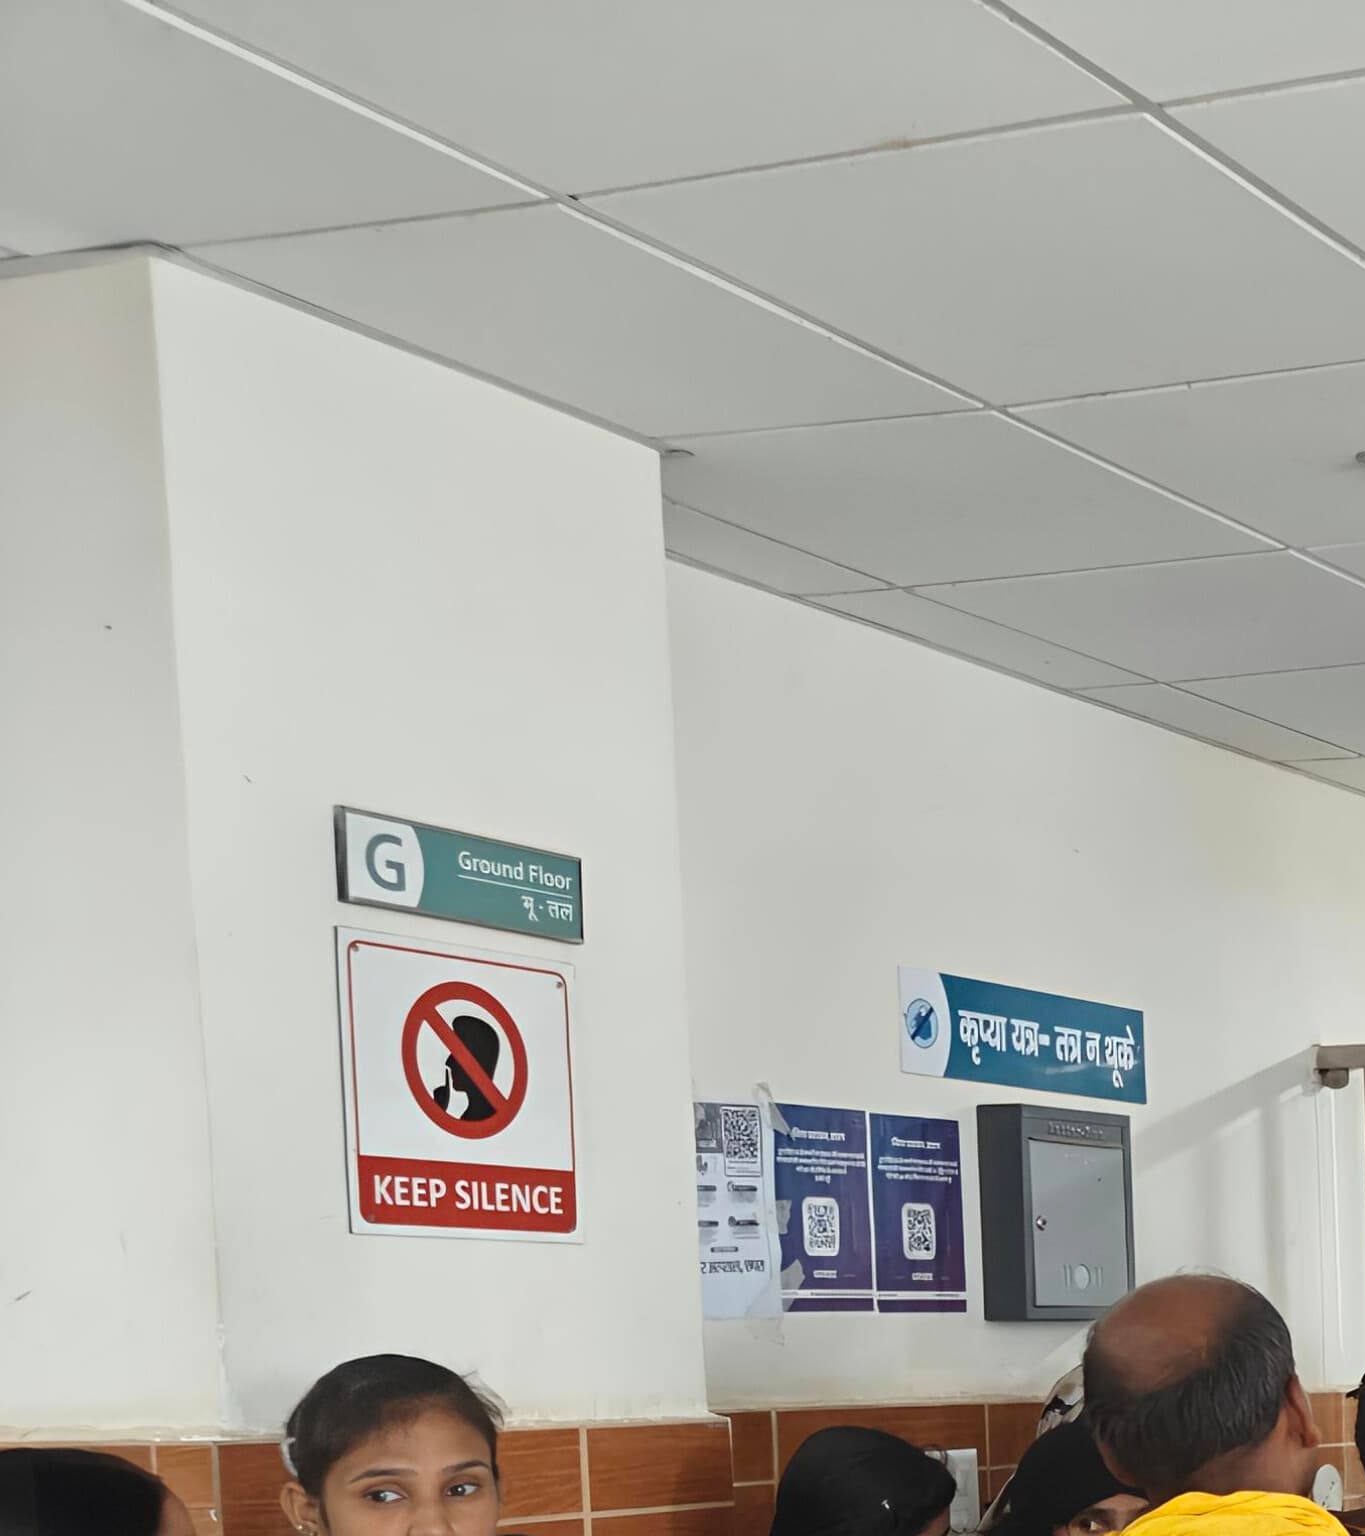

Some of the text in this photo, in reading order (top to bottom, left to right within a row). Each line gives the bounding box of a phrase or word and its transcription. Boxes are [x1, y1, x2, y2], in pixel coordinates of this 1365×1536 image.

[366, 834, 406, 892] G
[458, 851, 573, 890] Ground Floor
[1054, 1026, 1082, 1065] तत्र
[1085, 1031, 1100, 1067] न
[373, 1173, 564, 1215] KEEP SILENCE
